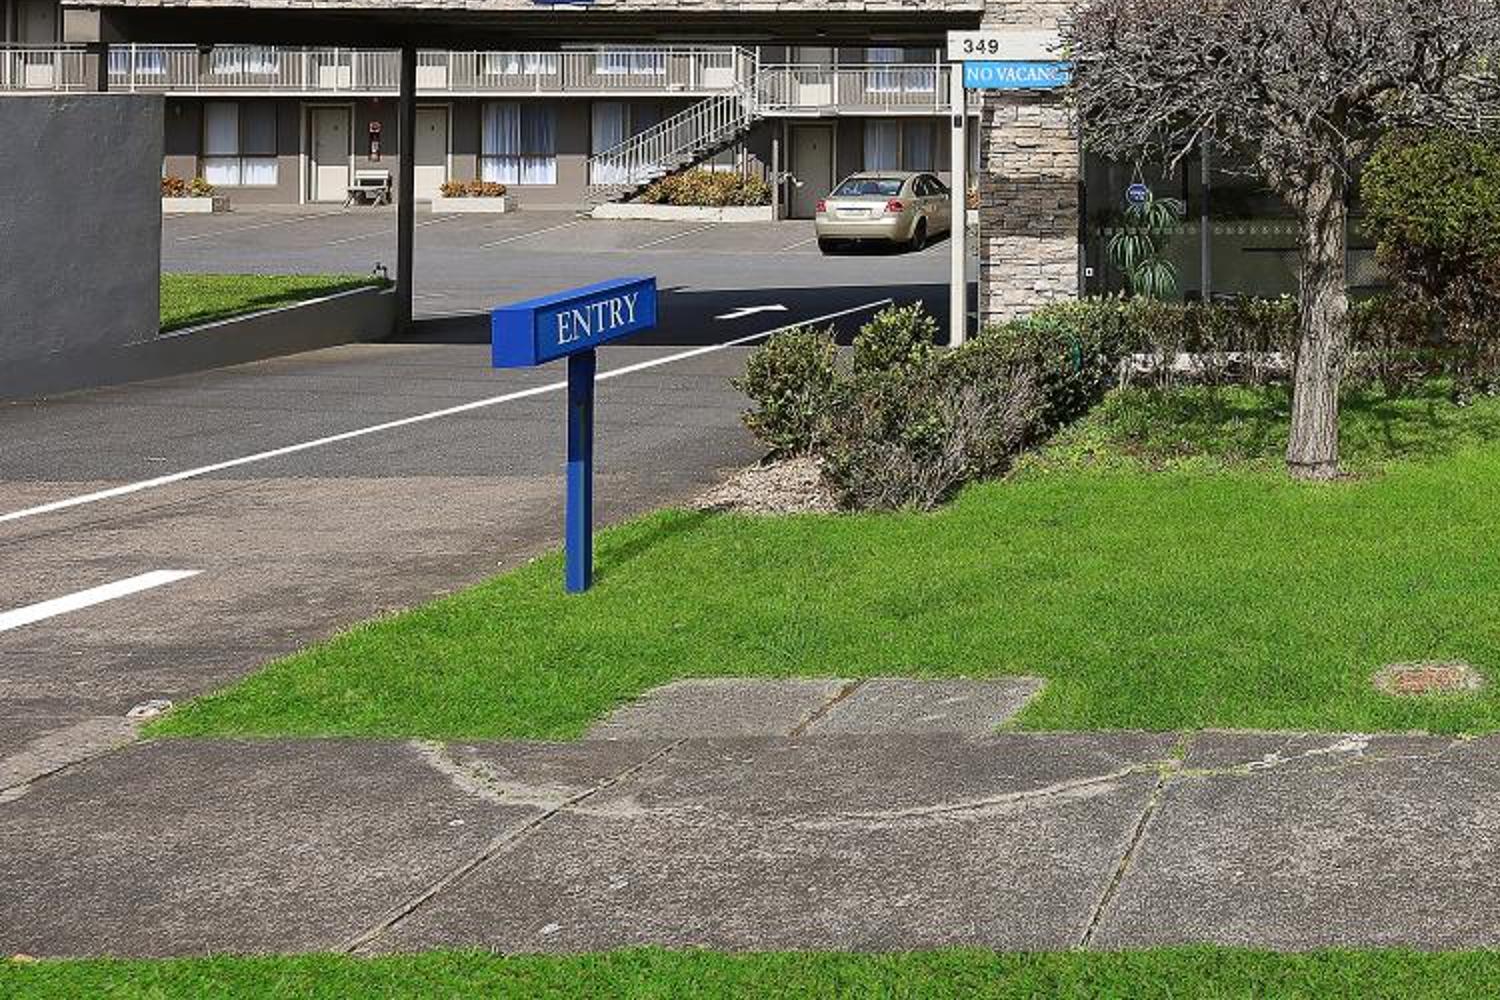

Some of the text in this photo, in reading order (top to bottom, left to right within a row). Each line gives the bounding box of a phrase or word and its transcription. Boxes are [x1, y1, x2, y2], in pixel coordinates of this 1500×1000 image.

[963, 39, 999, 54] 349
[967, 67, 993, 81] NO
[556, 292, 639, 345] ENTRY
